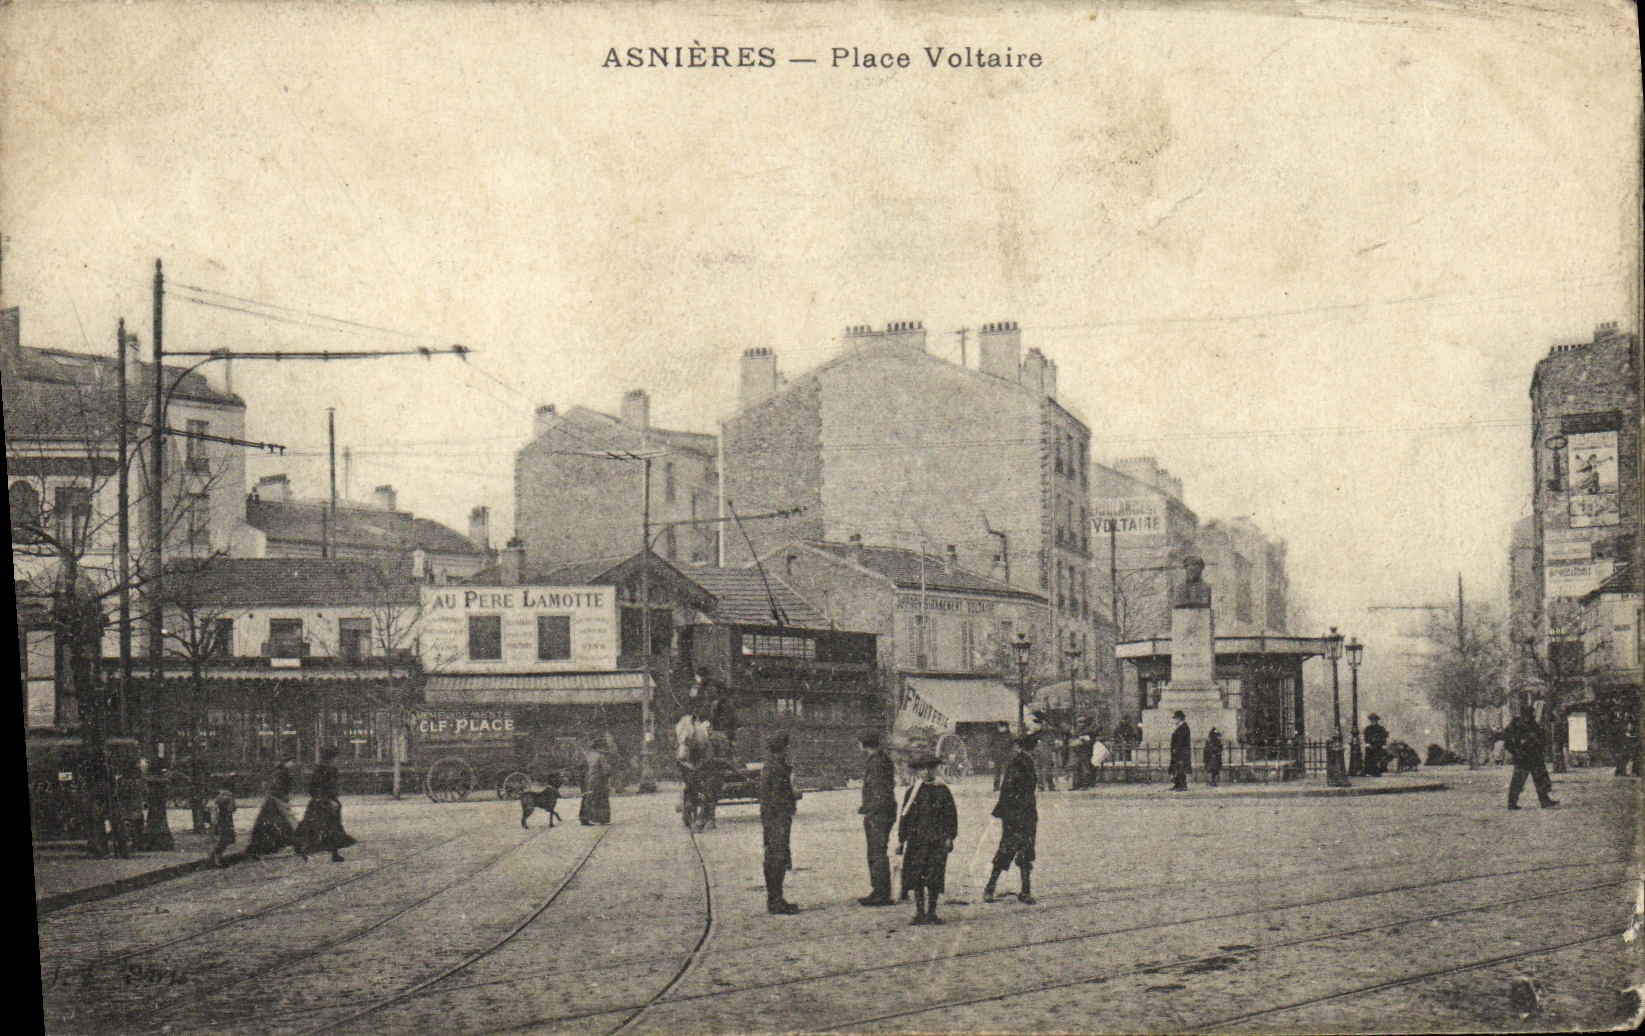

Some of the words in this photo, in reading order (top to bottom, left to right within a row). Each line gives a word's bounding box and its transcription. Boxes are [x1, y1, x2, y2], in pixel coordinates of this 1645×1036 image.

[434, 593, 456, 609] AU
[464, 591, 514, 609] PERE
[523, 590, 604, 609] LAMOTTE
